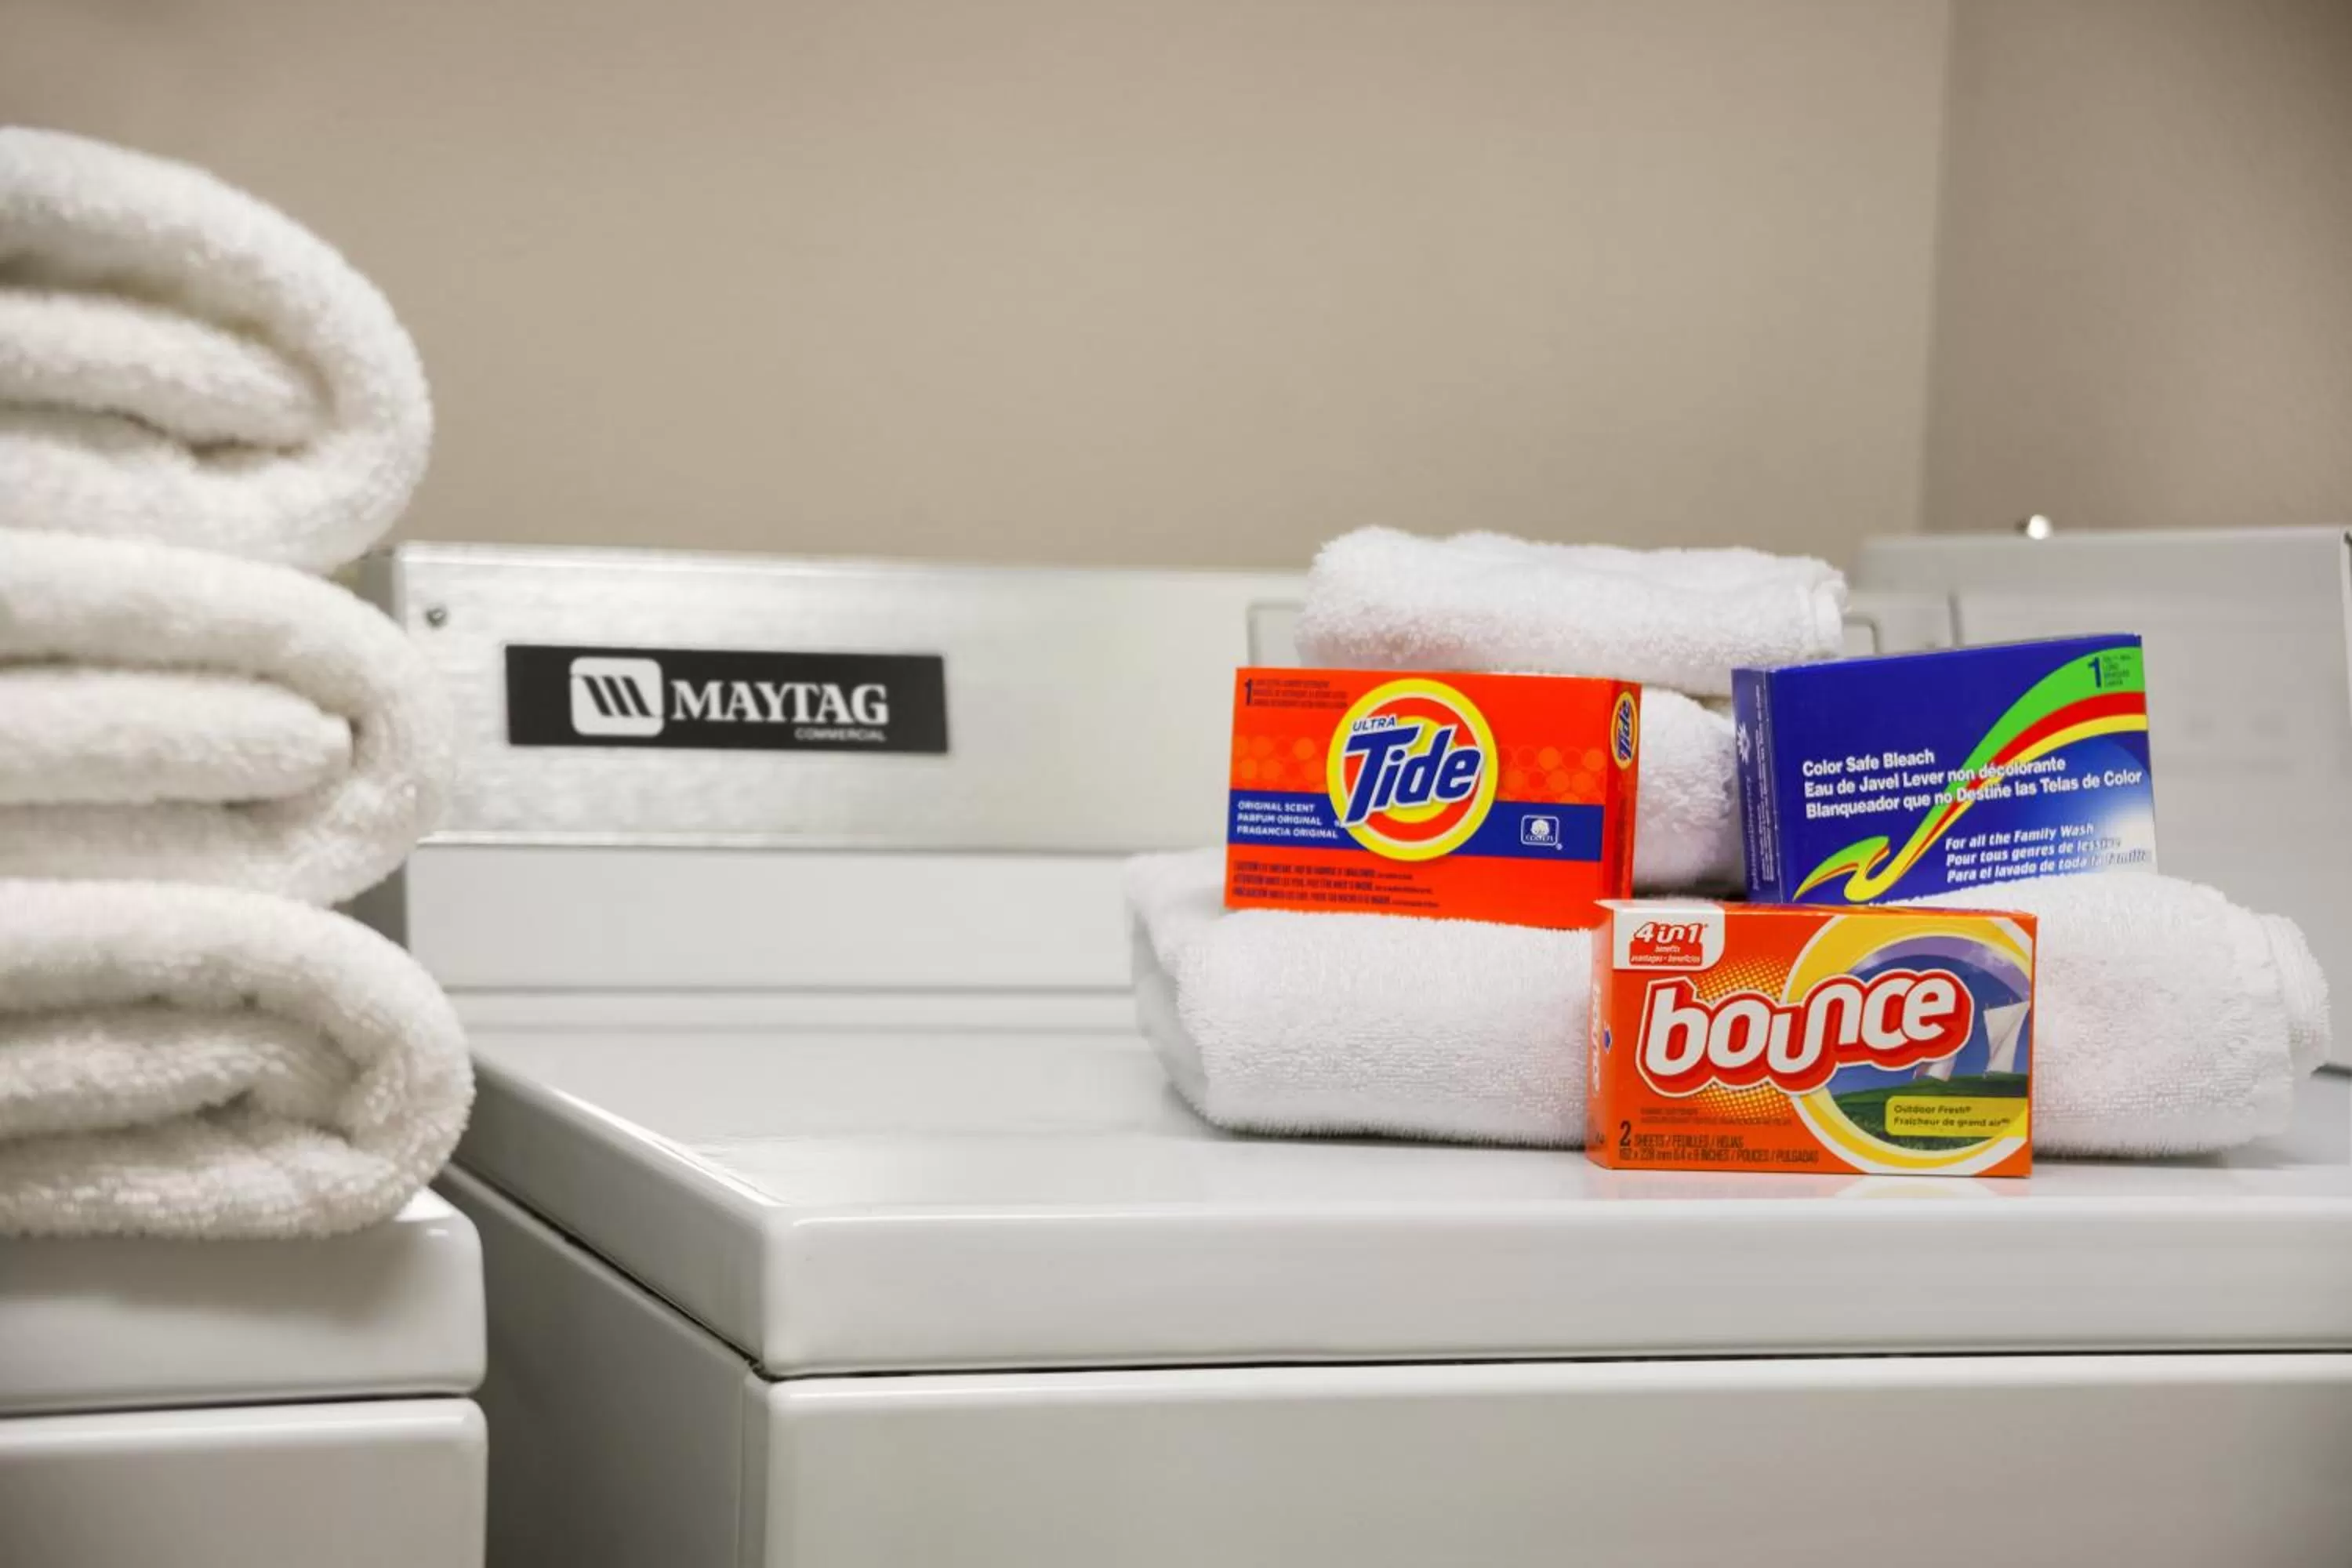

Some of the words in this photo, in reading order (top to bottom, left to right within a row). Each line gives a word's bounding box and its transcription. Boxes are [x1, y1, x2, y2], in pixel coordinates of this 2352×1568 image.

[2088, 656, 2101, 688] 1
[670, 679, 888, 725] MAYTAG
[1244, 678, 1252, 705] 1
[795, 727, 887, 742] COMMERCIAL
[1352, 717, 1396, 731] ULTRA
[1341, 724, 1481, 826] Tide
[1802, 760, 1842, 777] Color
[1846, 755, 1879, 772] Safe
[1883, 748, 1935, 768] Bleach
[1804, 781, 1834, 798] Eau
[1837, 778, 1856, 794] de
[1859, 773, 1900, 792] Javel
[1903, 771, 1945, 787] Lever
[1947, 768, 1975, 782] non
[1978, 757, 2066, 779] décolorante
[1238, 800, 1283, 811] ORIGINAL
[1285, 803, 1315, 812] SCENT
[1806, 796, 1900, 819] Blanqueador
[1903, 794, 1931, 811] que
[1934, 792, 1953, 804] no
[2015, 782, 2037, 797] las
[2040, 776, 2079, 793] Telas
[2082, 774, 2100, 789] de
[2104, 769, 2142, 786] Color
[1237, 813, 1275, 822] PARFUM
[1277, 815, 1323, 826] ORIGINAL
[1237, 826, 1290, 837] FRAGANCIA
[1294, 828, 1338, 838] ORIGINAL
[1945, 837, 1966, 851] For
[1969, 834, 1986, 848] all
[1989, 833, 2010, 846] the
[2013, 827, 2056, 844] Family
[2060, 823, 2095, 837] Wash
[1947, 853, 1976, 867] Pour
[1980, 849, 2008, 863] tous
[2012, 844, 2055, 862] genres
[2058, 840, 2074, 854] de
[1947, 869, 1976, 884] Para
[1980, 866, 1991, 879] el
[1994, 861, 2036, 878] lavado
[2039, 858, 2053, 873] de
[2058, 855, 2087, 870] toda
[1646, 976, 1957, 1076] bounce
[1893, 1104, 1936, 1114] Outdoor
[1942, 1117, 1955, 1126] de
[1957, 1119, 1987, 1128] grand
[1619, 1120, 1632, 1146] 2
